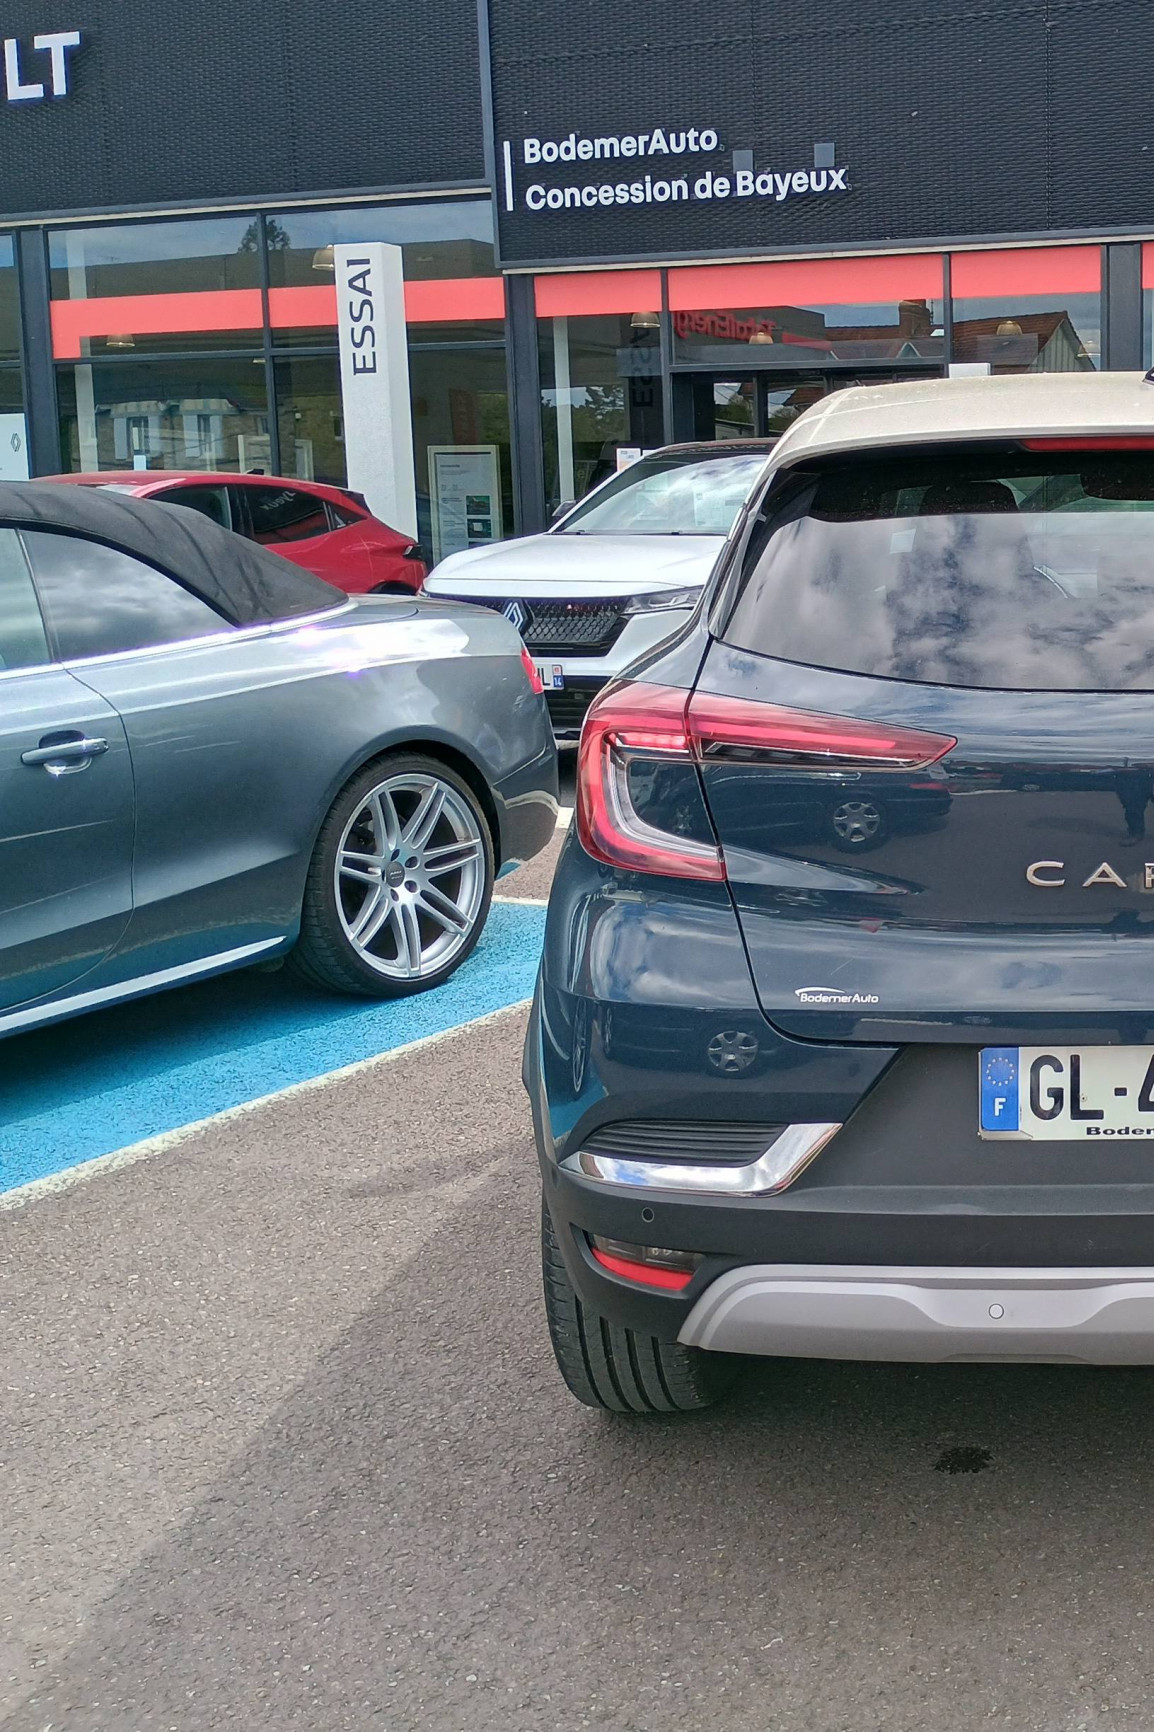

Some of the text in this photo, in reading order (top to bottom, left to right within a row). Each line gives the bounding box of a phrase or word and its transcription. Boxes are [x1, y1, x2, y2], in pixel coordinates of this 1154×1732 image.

[4, 31, 80, 100] LT
[524, 128, 718, 164] BodemerAuto
[525, 168, 847, 211] Concession de Bayeux
[346, 258, 377, 375] ESSAI
[800, 993, 879, 1003] BodemerAuto
[994, 1097, 1006, 1116] F
